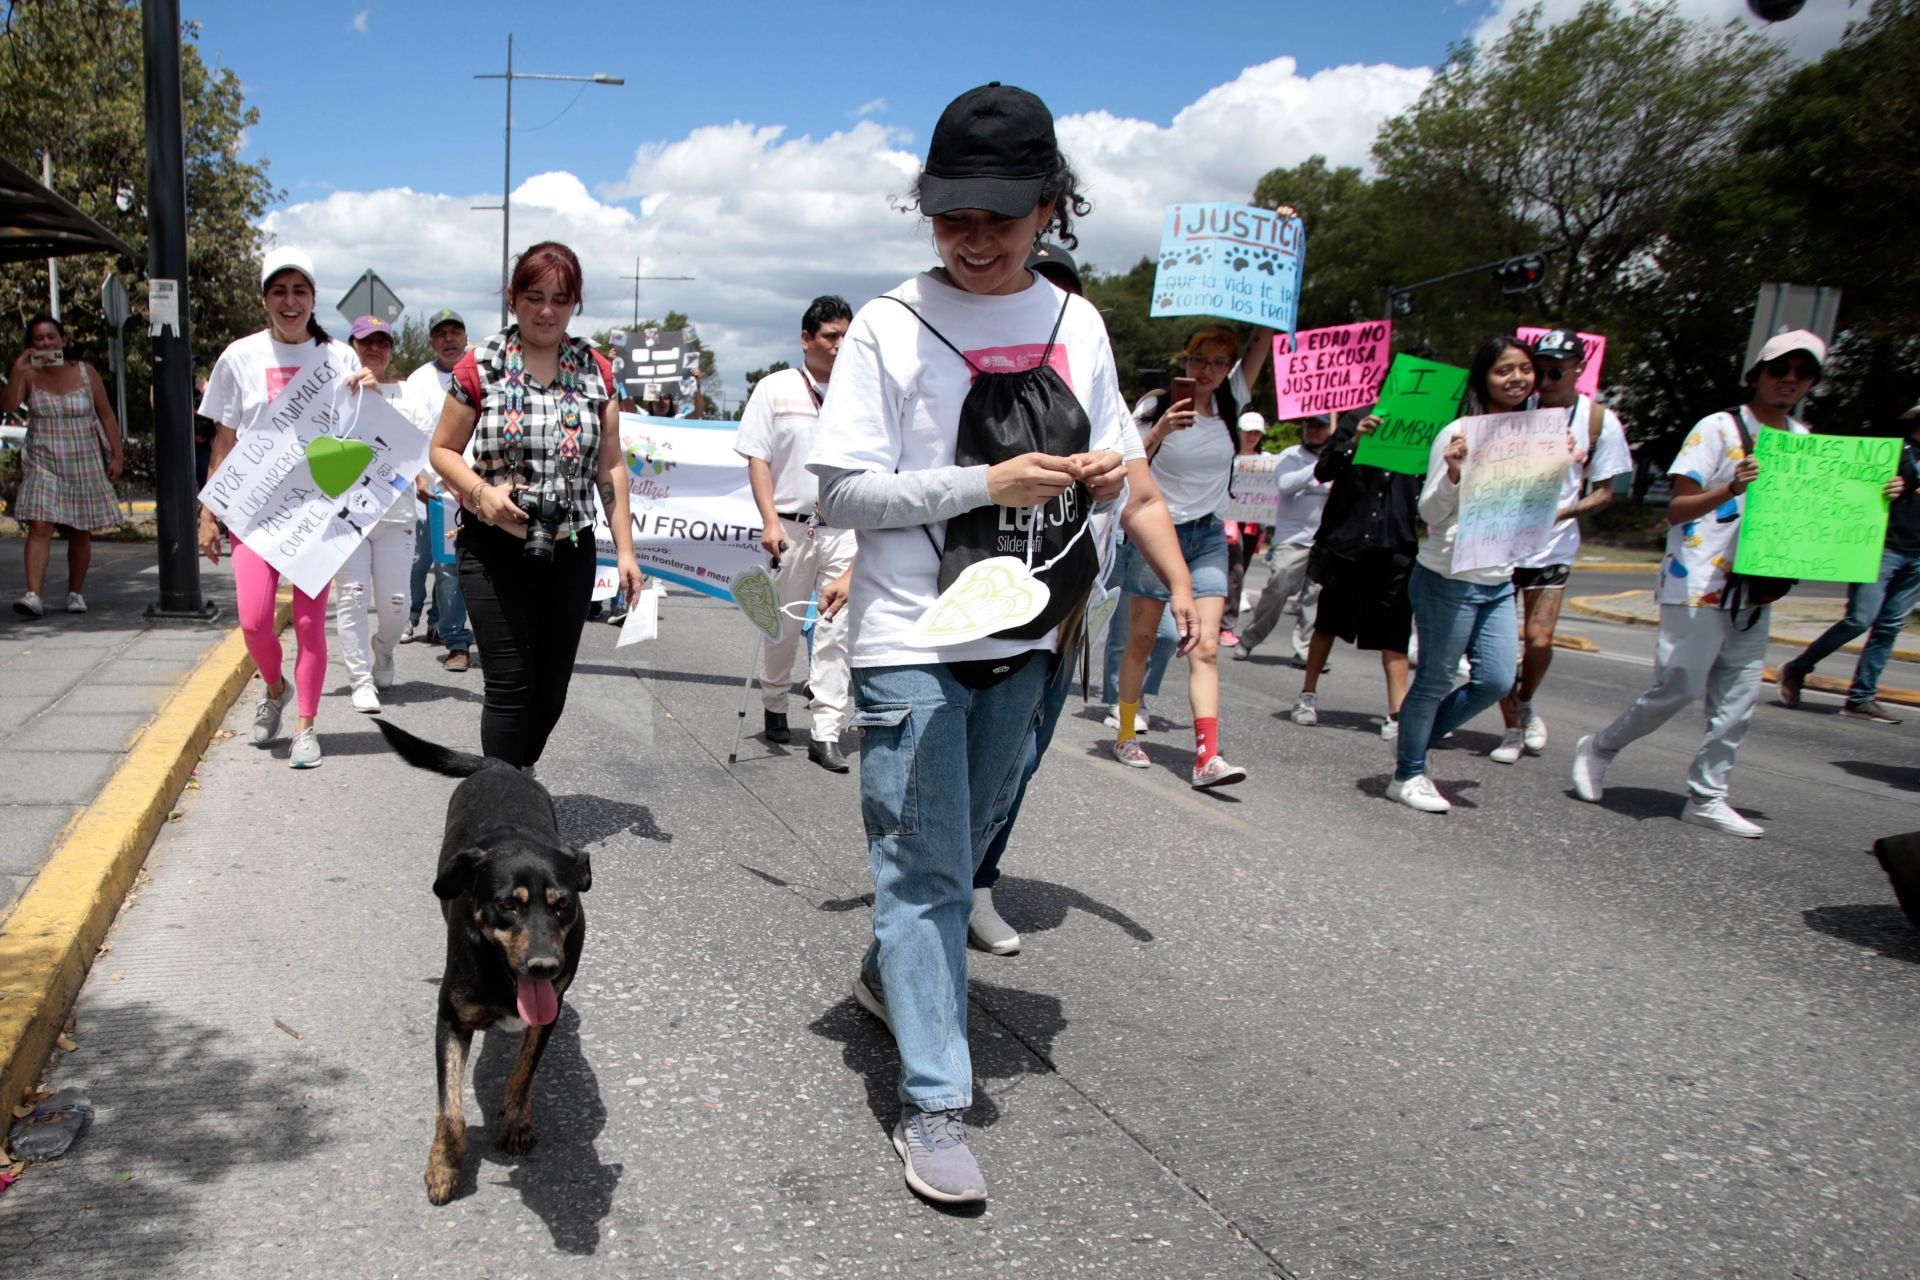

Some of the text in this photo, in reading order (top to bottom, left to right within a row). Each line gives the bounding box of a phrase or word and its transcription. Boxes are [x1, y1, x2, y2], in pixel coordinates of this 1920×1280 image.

[1225, 276, 1253, 296] vida
[1177, 293, 1223, 309] como
[1231, 295, 1254, 315] los
[1308, 330, 1351, 350] EDAD
[1357, 324, 1386, 345] NO
[1289, 345, 1377, 375] ES EXCUSA
[1282, 372, 1351, 396] JUSTICIA
[243, 433, 275, 466] LOS
[1855, 439, 1894, 467] NO
[279, 505, 329, 558] CUMPLE
[636, 552, 650, 561] sin
[652, 554, 696, 573] fronteras
